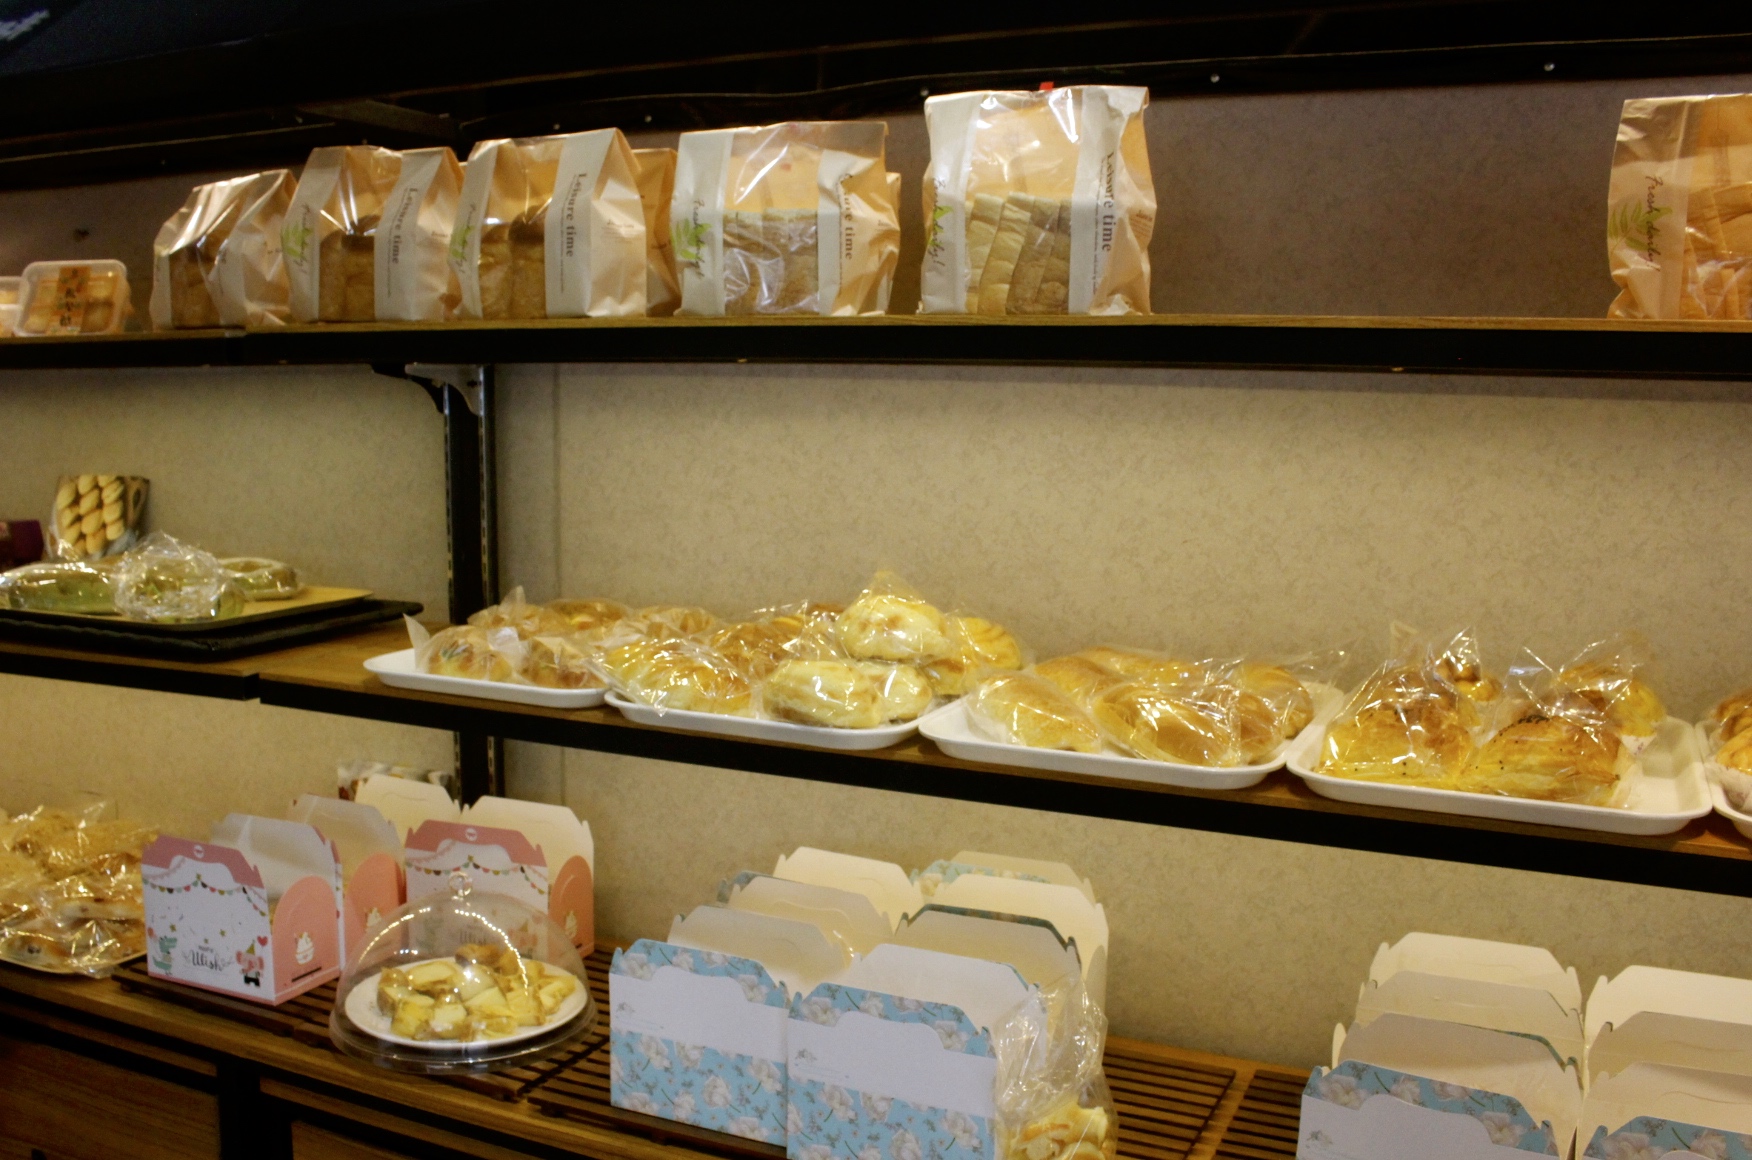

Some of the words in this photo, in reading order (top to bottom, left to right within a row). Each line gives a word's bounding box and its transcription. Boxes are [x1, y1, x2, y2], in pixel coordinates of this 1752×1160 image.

[566, 172, 587, 221] Leisure
[1102, 151, 1114, 210] Leisure
[1644, 175, 1664, 215] Fresh
[394, 187, 418, 231] Leisure
[392, 235, 403, 265] time
[566, 225, 577, 258] time
[845, 226, 856, 260] time
[1101, 215, 1118, 252] time
